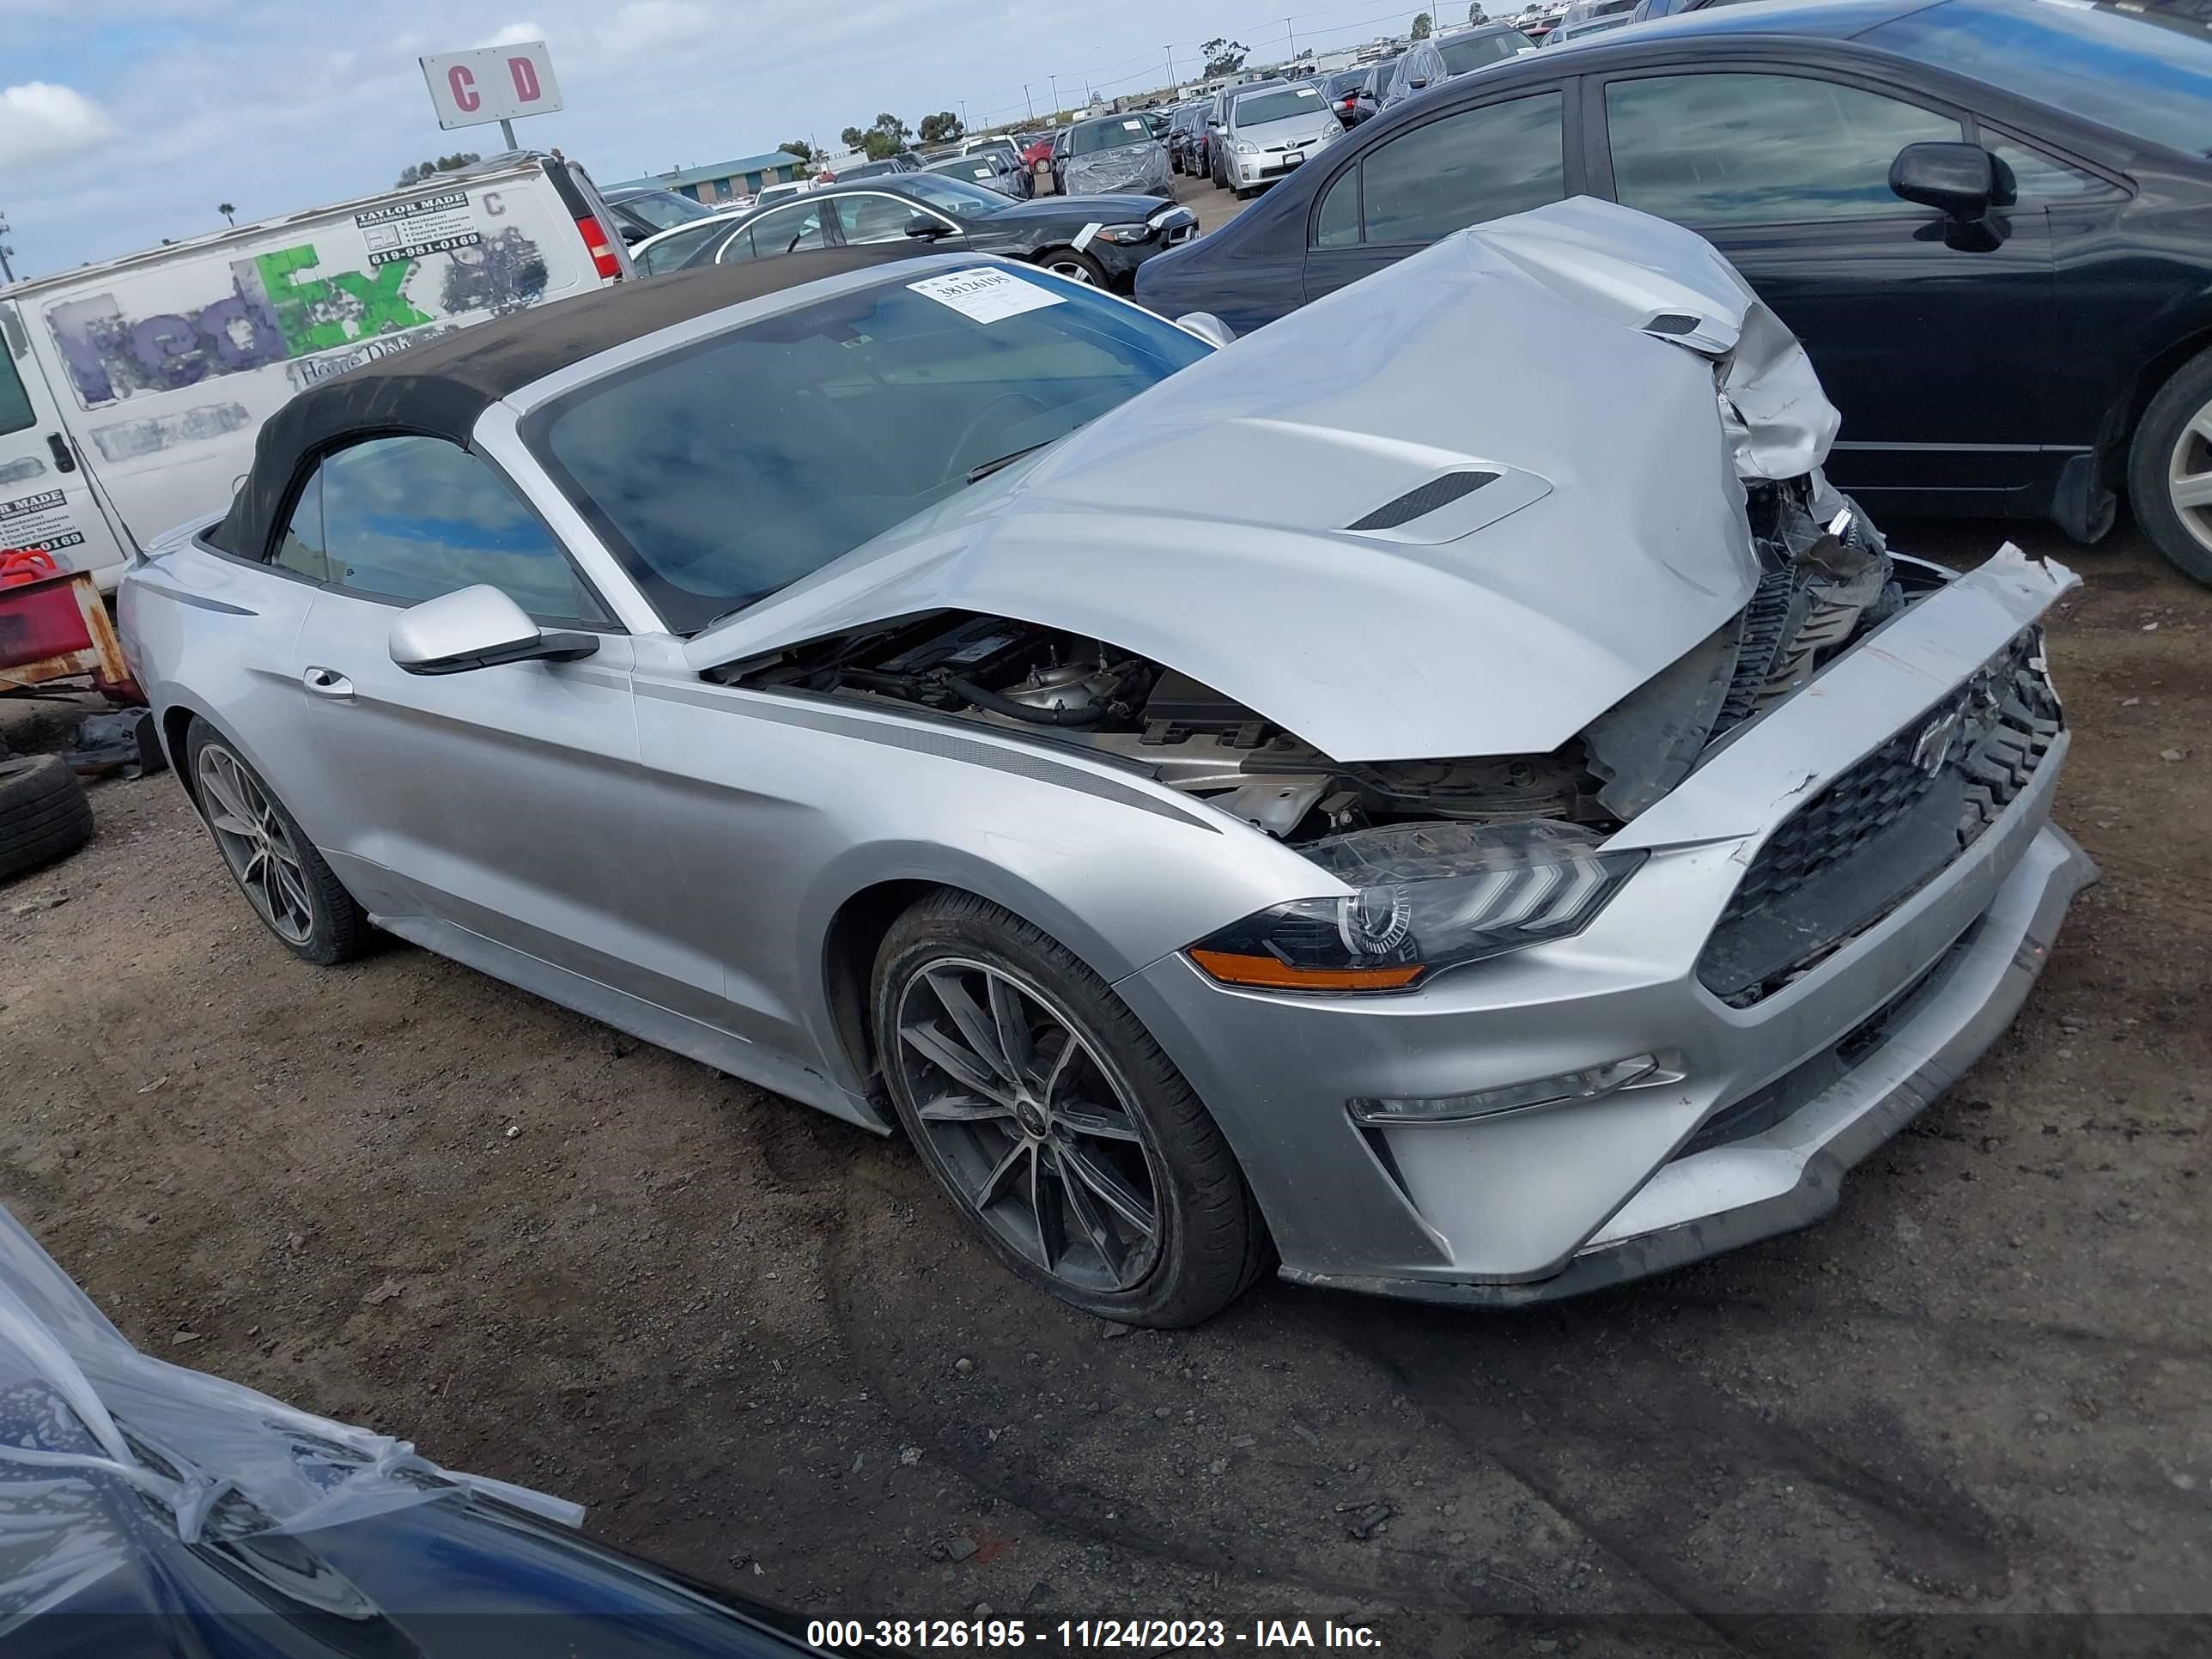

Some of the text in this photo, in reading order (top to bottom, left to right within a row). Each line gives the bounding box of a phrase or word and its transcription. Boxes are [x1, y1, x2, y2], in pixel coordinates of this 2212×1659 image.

[448, 57, 540, 112] C D
[356, 193, 465, 222] TAYLOR MADE
[359, 200, 467, 228] PROFESSIONAL WINDOW CLEANING
[407, 214, 447, 225] Residential
[425, 216, 470, 227] Construction
[434, 226, 474, 238] Commercial
[371, 234, 478, 264] 619-981-0169
[936, 275, 1012, 299] 38126195
[14, 491, 62, 509] MADE
[30, 500, 65, 511] CLEANING
[2, 514, 45, 528] Residential
[21, 515, 70, 529] Construction
[33, 525, 76, 540] Commercial
